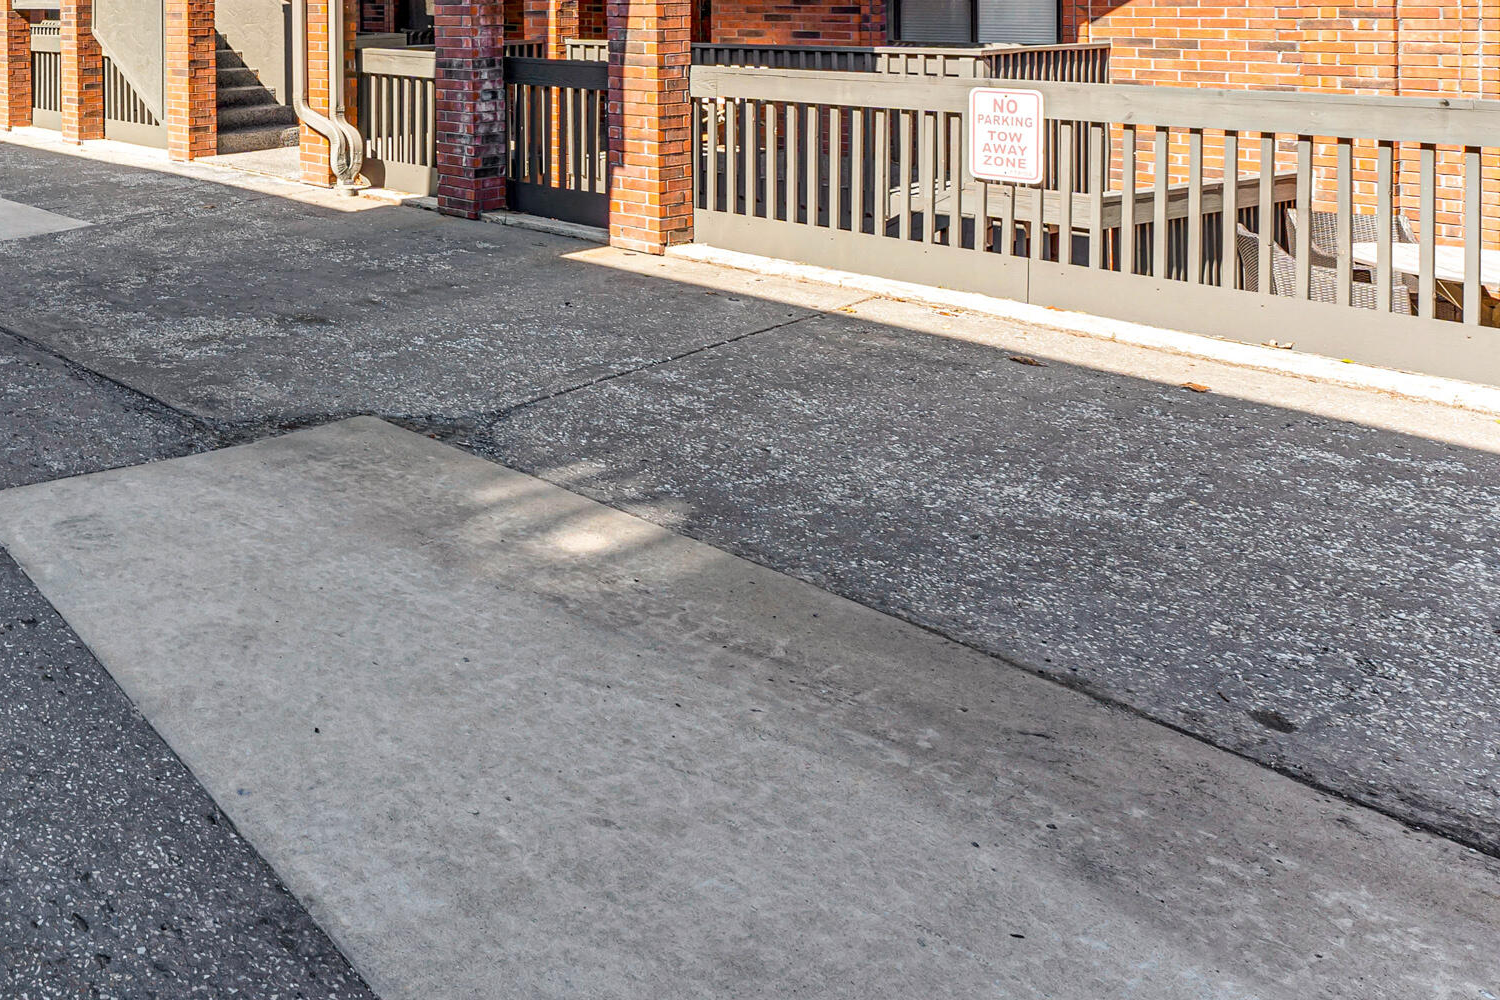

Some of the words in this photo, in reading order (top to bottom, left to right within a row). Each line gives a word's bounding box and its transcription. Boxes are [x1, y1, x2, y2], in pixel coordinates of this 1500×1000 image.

[993, 98, 1018, 114] NO
[977, 113, 1033, 128] PARKING
[987, 130, 1022, 143] TOW
[982, 142, 1027, 156] AWAY
[983, 155, 1027, 169] ZONE
